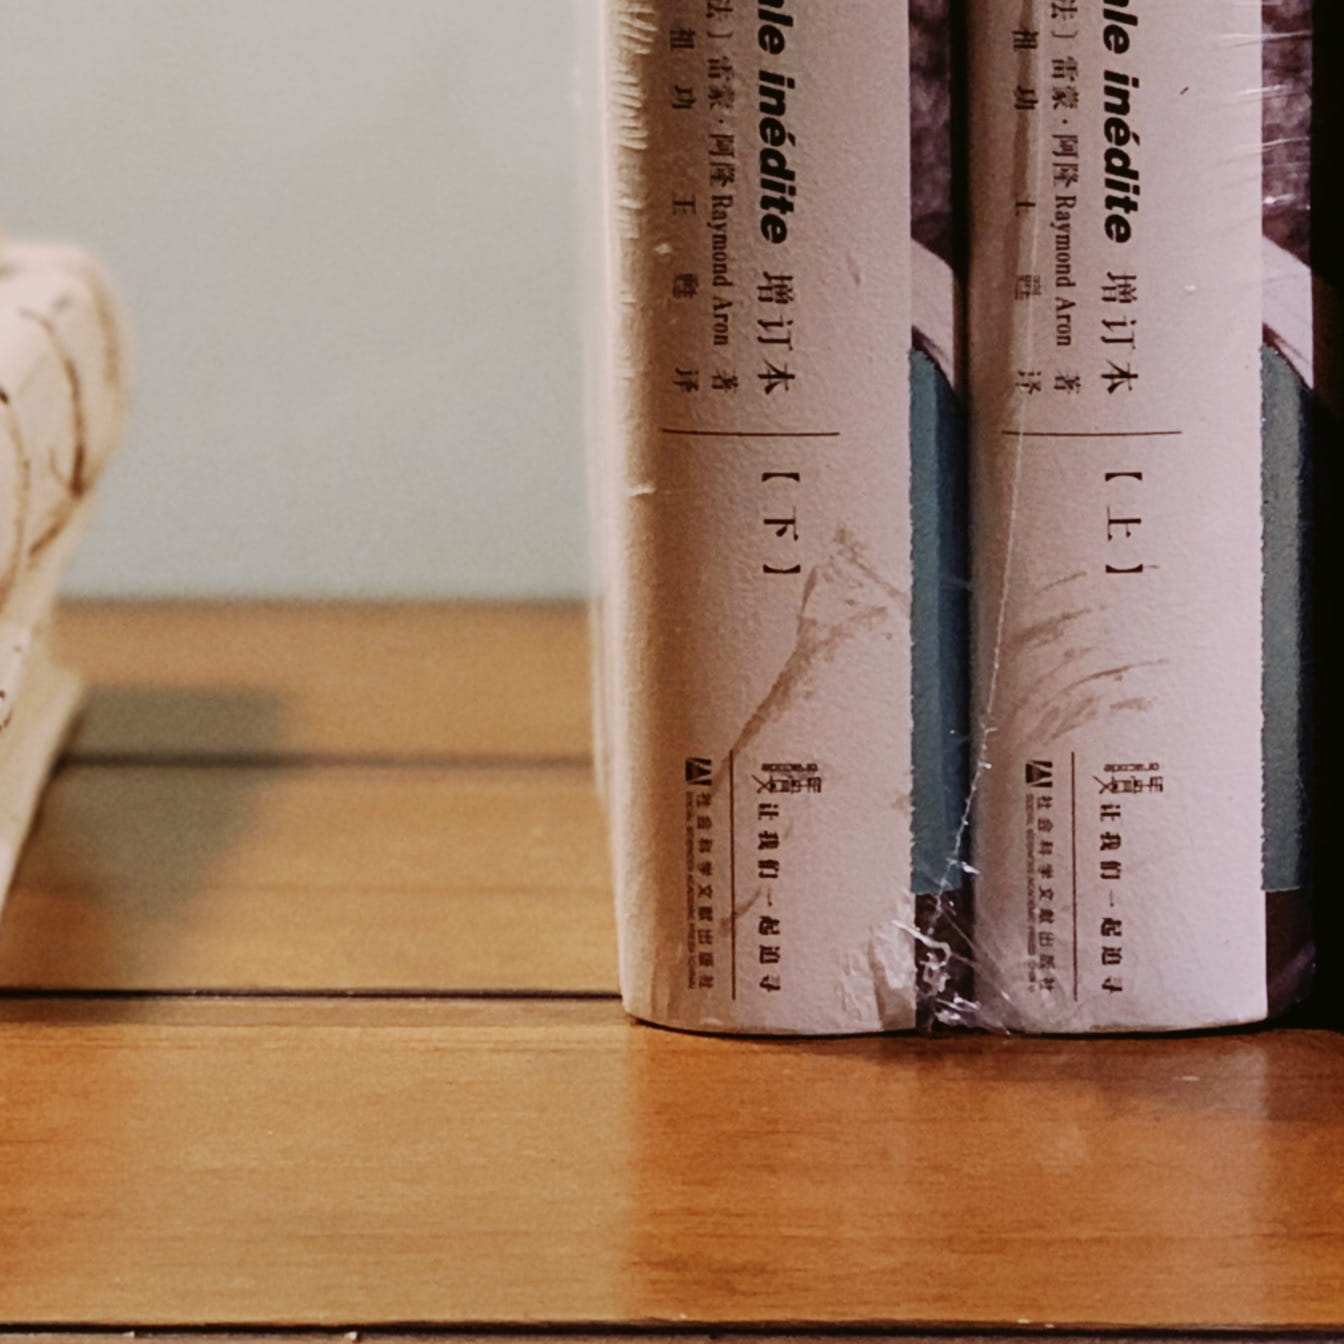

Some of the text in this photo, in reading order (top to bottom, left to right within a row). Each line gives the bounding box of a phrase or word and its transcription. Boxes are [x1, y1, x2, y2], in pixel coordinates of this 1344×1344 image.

[758, 70, 796, 244] inédite
[1104, 70, 1140, 243] inédite
[711, 193, 734, 287] Raymond
[1053, 194, 1077, 287] Raymond
[713, 296, 734, 346] Aron
[756, 271, 795, 395] 增订本
[1055, 296, 1076, 346] Aron
[1100, 272, 1139, 394] 增订本
[696, 791, 715, 990] 社会科学文献出版社
[755, 802, 782, 993] 让我们一起追寻
[1037, 795, 1055, 992] 社会科学文献出版社
[1099, 802, 1124, 994] 让我们一起追寻
